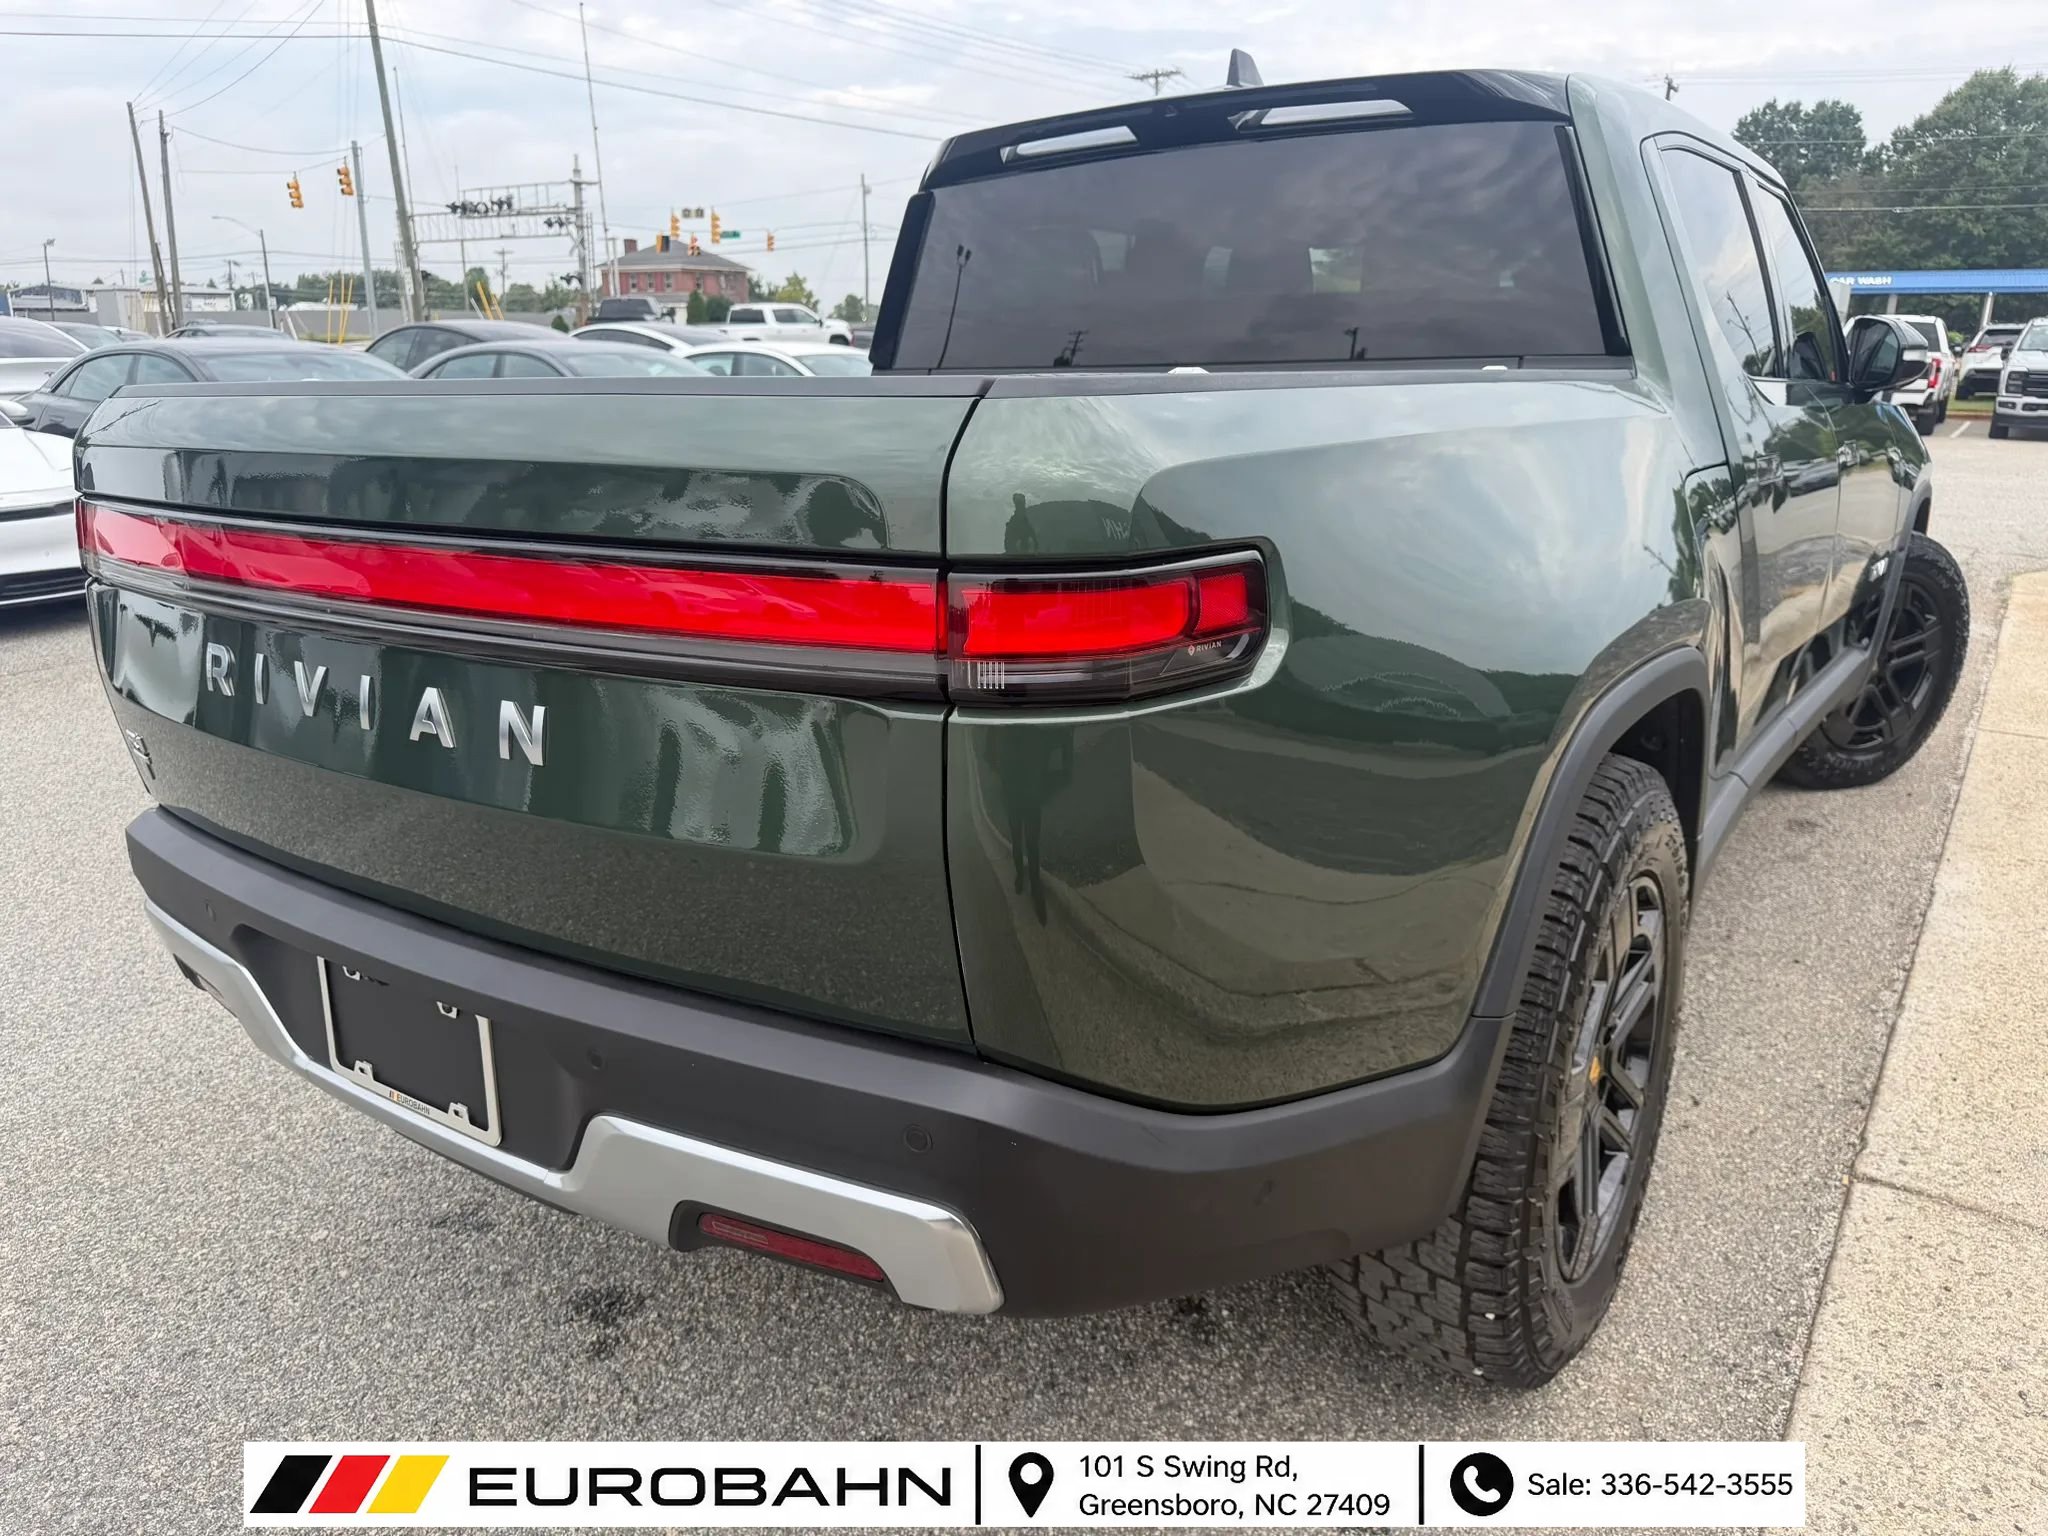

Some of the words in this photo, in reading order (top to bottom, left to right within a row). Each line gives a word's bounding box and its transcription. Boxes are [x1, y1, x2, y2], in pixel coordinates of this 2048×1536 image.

[1857, 276, 1892, 285] WASH
[1196, 640, 1222, 652] RIVIAN
[205, 641, 548, 767] RIVIAN
[397, 1093, 431, 1116] EUROBAHN
